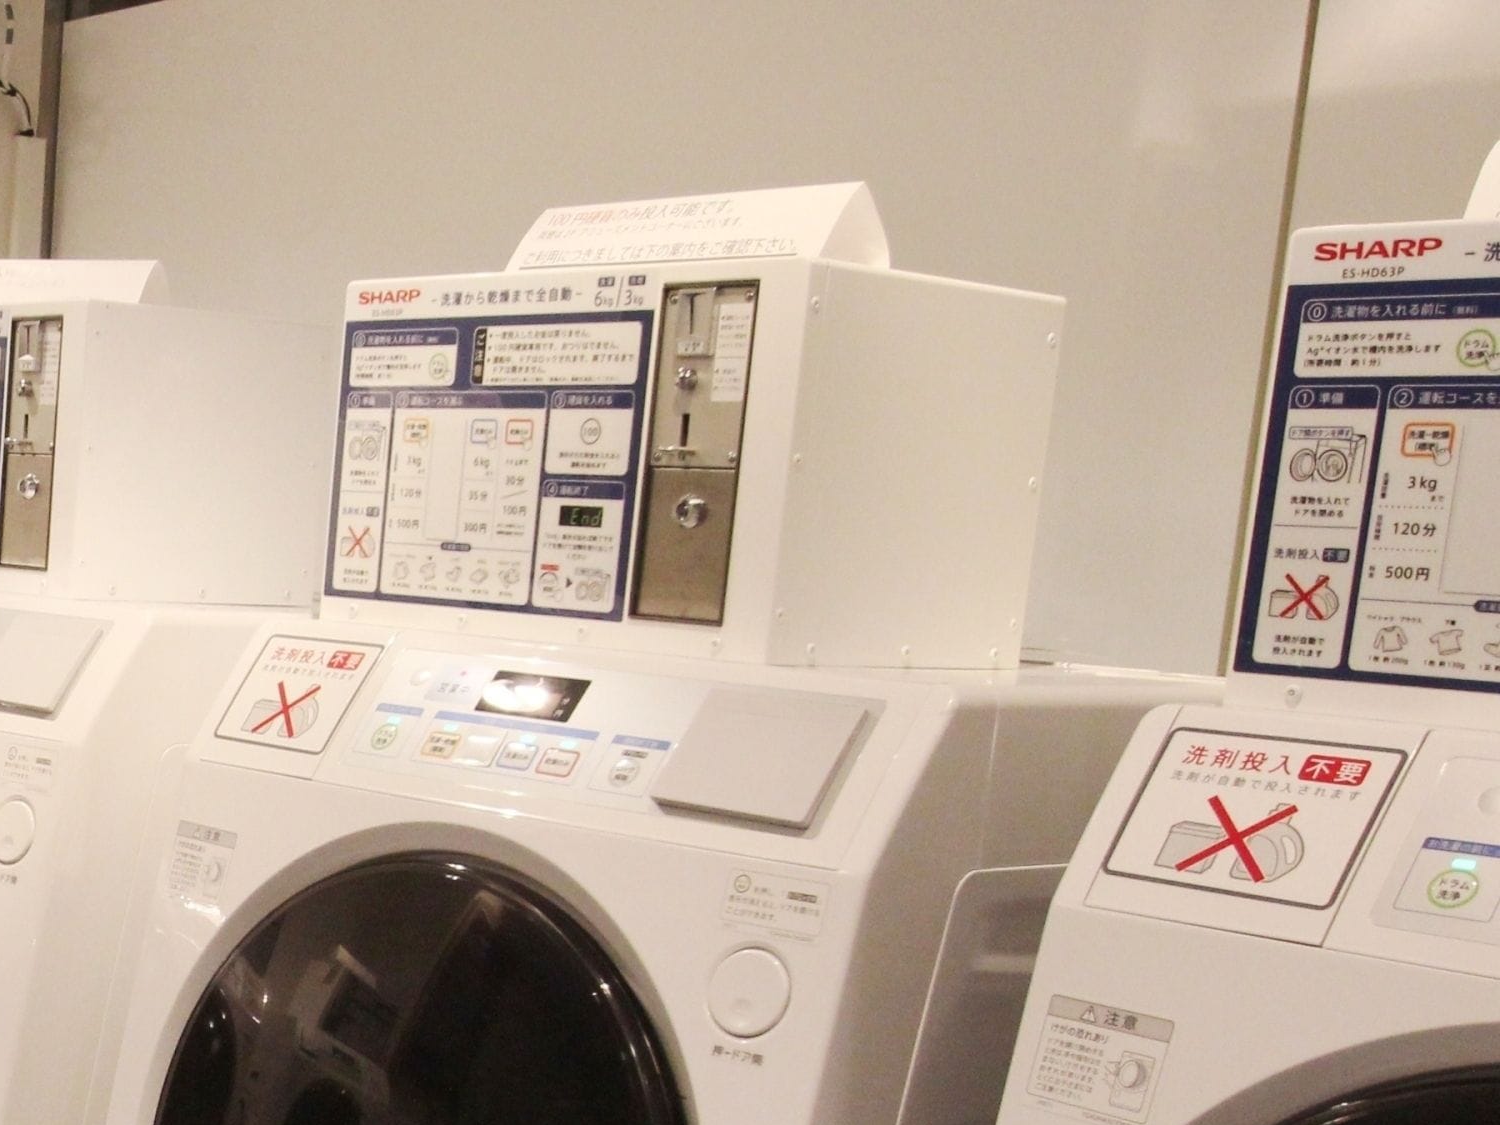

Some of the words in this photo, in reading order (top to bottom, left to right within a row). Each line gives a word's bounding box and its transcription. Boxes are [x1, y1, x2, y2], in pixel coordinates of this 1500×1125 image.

[1314, 237, 1443, 262] SHARP
[1342, 266, 1405, 279] ES-HD63P
[358, 288, 421, 306] SHARP
[1331, 303, 1447, 319] 洗濯物を入れる前に
[1463, 339, 1490, 349] ドラム
[1319, 392, 1345, 405] 準備
[1290, 496, 1351, 505] 洗濯物を入れて
[570, 508, 602, 526] End
[1294, 509, 1344, 518] ドアを閉める
[1393, 523, 1437, 537] 120分
[1274, 547, 1320, 560] 洗剤投入
[1385, 566, 1431, 581] 500円
[1274, 634, 1325, 645] 洗剤が自動で
[270, 647, 326, 666] 洗剤投入
[330, 651, 364, 670] 不要
[1272, 647, 1324, 658] 投入されます
[1182, 744, 1292, 776] 洗剤投入
[1302, 757, 1367, 785] 不要
[1170, 769, 1362, 801] 洗剤が自動で投入されます
[1439, 878, 1470, 891] ドラム
[1104, 1009, 1140, 1031] 注意
